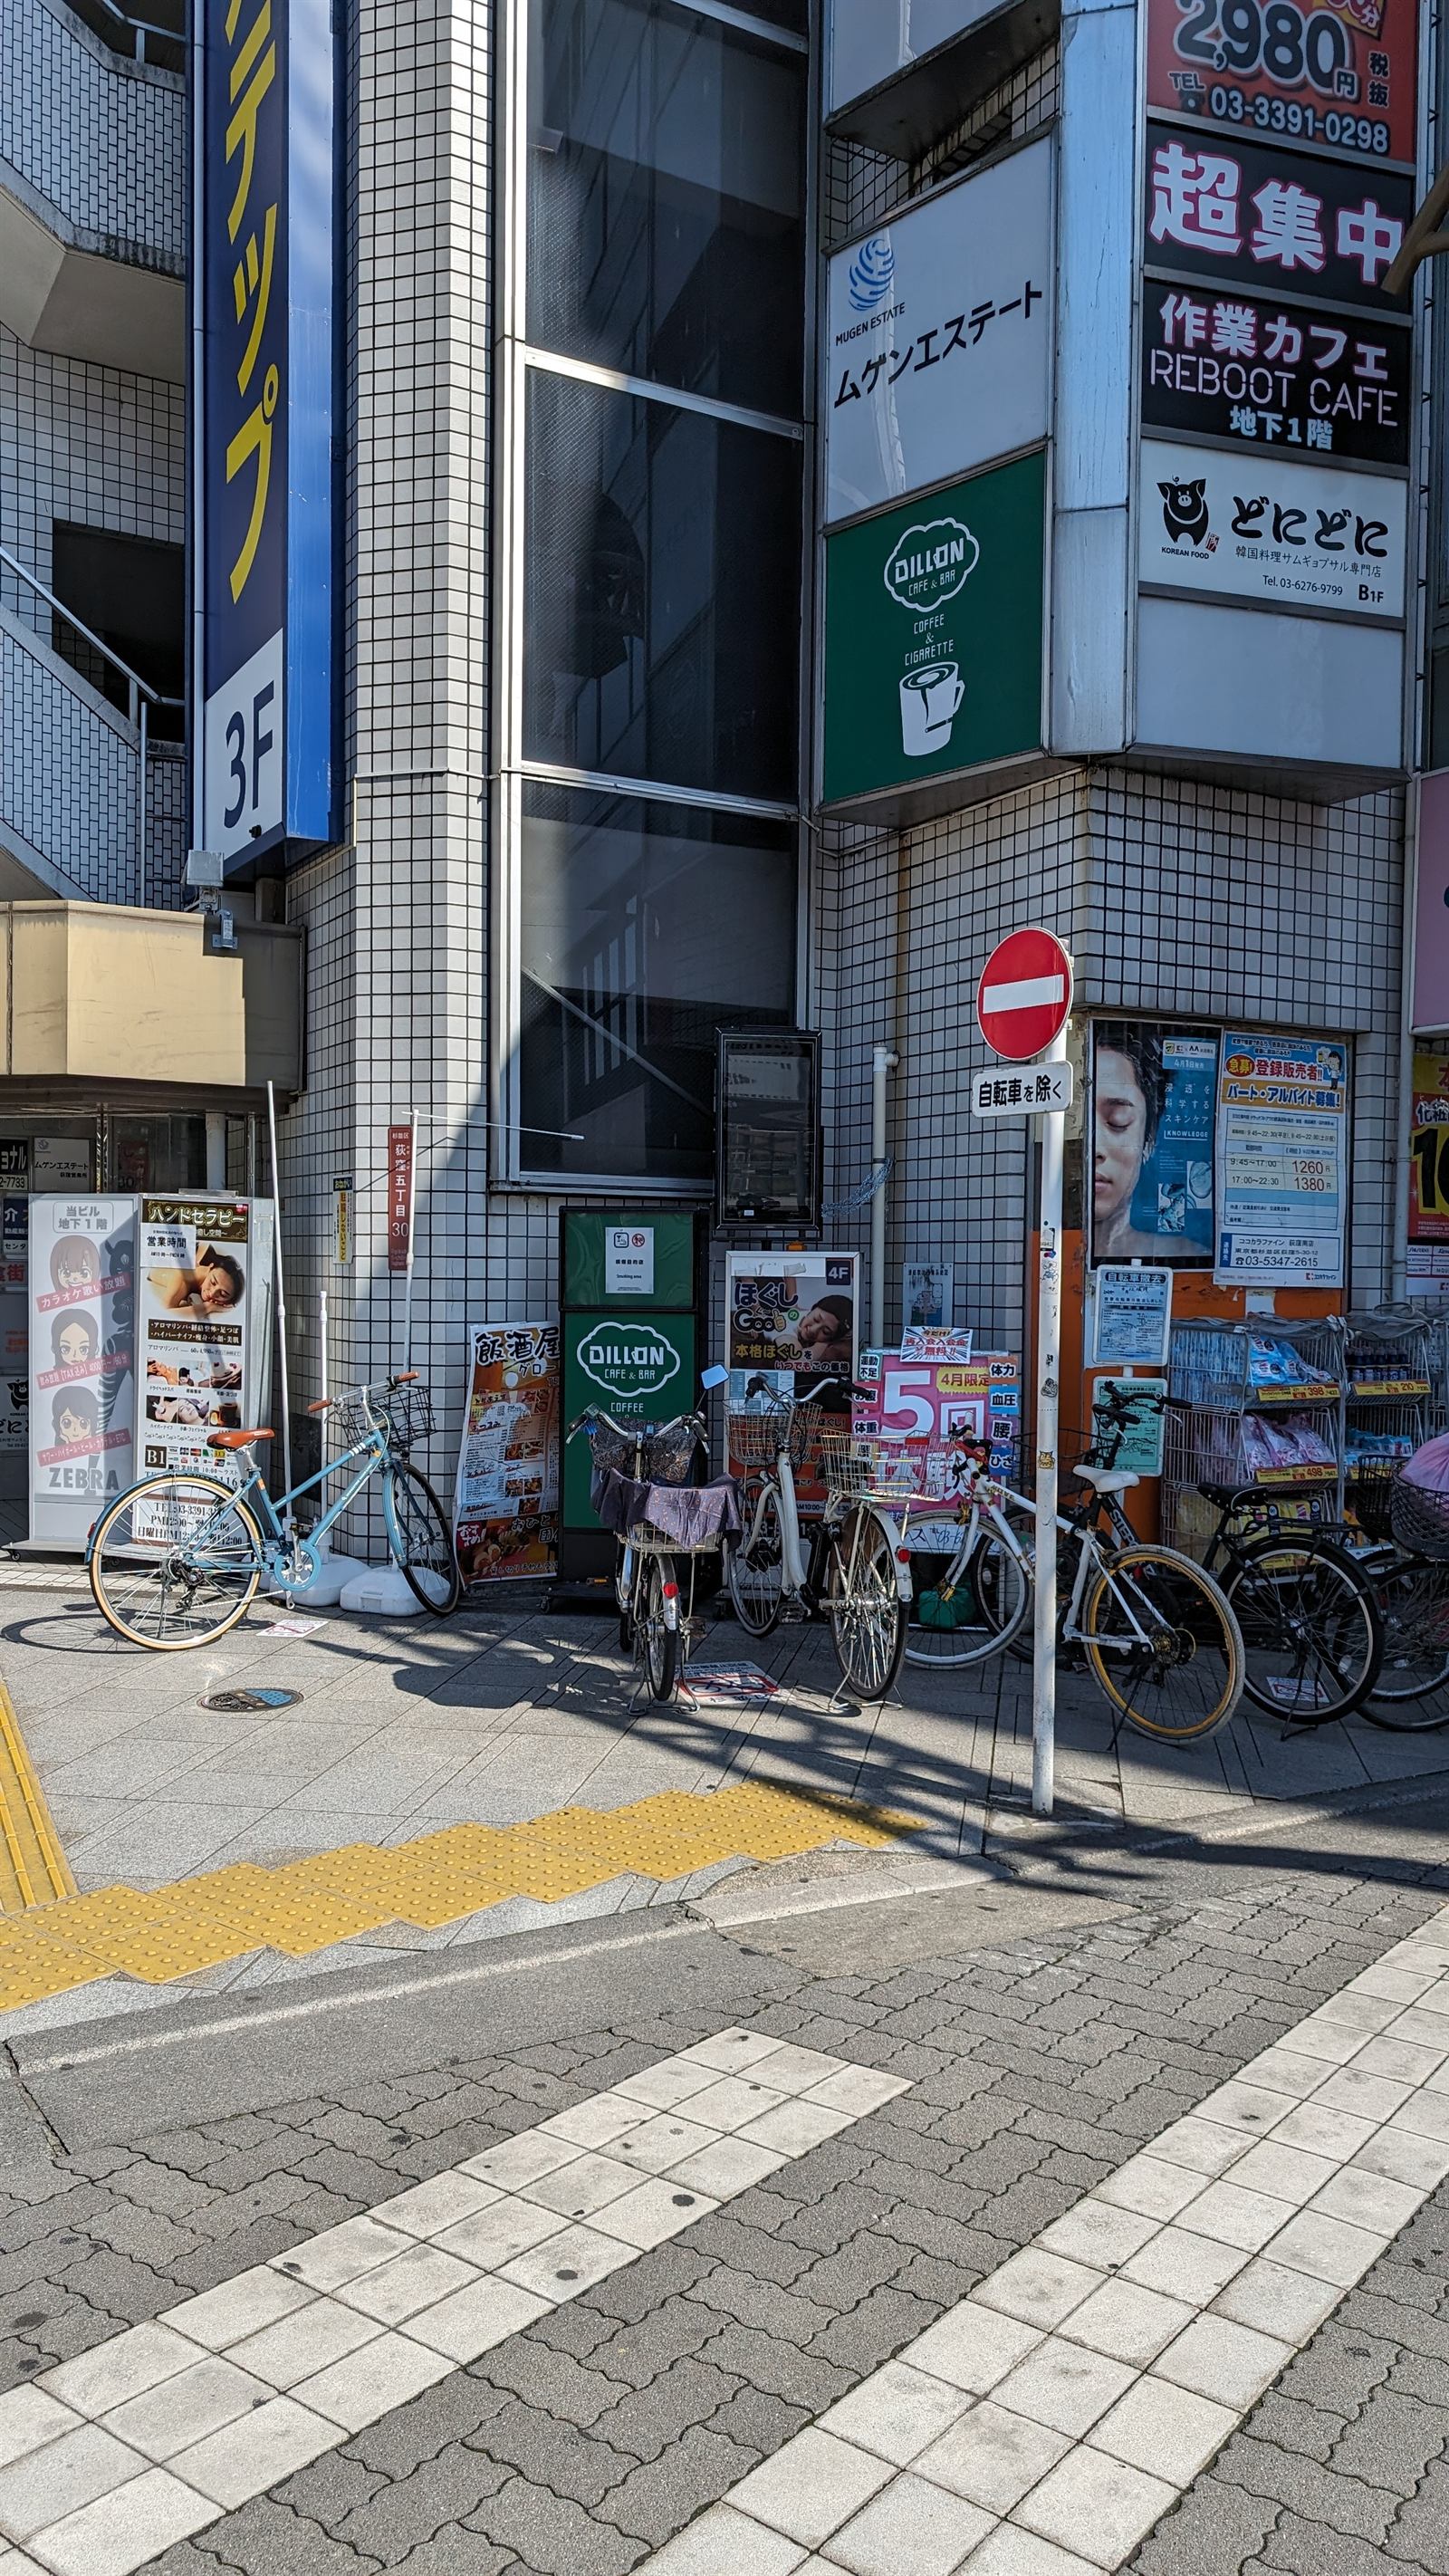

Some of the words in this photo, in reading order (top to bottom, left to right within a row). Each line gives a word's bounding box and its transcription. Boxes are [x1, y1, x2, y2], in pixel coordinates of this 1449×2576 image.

[1169, 72, 1205, 90] TEL
[1368, 51, 1389, 107] 税抜
[1211, 87, 1389, 154] 03-3391-0298
[1149, 142, 1403, 284] 超集中
[836, 321, 869, 346] MUGEN
[870, 302, 906, 329] ESTATE
[834, 280, 1042, 409] ムゲンエステート
[1159, 293, 1389, 381] 作業カフェ
[1150, 349, 1296, 408] REBOOT
[1310, 379, 1398, 427] CAFE
[1230, 405, 1334, 450] 地下1階
[1232, 495, 1388, 557] どにどに
[895, 537, 964, 584] DILLON
[1161, 546, 1190, 558] KOREAN
[1191, 549, 1210, 560] FOOD
[1235, 545, 1382, 579] 韓国料理サムギョプサル専門店
[908, 580, 928, 596] CAFE
[930, 580, 938, 590] &
[940, 570, 955, 587] BAR
[1262, 575, 1278, 588] Tel.
[1280, 578, 1343, 596] 03-6276-9799
[1358, 583, 1384, 603] B1F
[914, 614, 945, 634] COFFEE
[926, 632, 935, 644] &
[905, 639, 954, 666] CIGARETTE
[224, 679, 274, 830] 3F
[1256, 1059, 1322, 1081] 登録販売者!!
[979, 1074, 1061, 1108] 自転車を除く
[1227, 1084, 1340, 1109] パート・アルバイト募集!
[1165, 1115, 1209, 1124] スキンケア
[1167, 1129, 1208, 1139] KNOWLEDGE
[34, 1160, 88, 1170] ムゲンエステート
[395, 1144, 407, 1217] 荻窪五丁目
[66, 1206, 101, 1217] 当ビル
[150, 1206, 245, 1227] ハンドセラピー
[58, 1218, 108, 1230] 地下1階
[392, 1223, 408, 1237] 30
[147, 1235, 187, 1249] 営業時間
[1239, 1238, 1285, 1246] ココカラファイン
[1245, 1256, 1319, 1266] 03-5347-2615
[828, 1267, 849, 1279] 4F
[42, 1276, 125, 1308] カラオケ歌い放題
[734, 1283, 799, 1307] ほぐし
[475, 1326, 560, 1365] 飯酒屋
[590, 1346, 665, 1365] DILLON
[860, 1356, 878, 1366] 運動
[604, 1369, 627, 1379] CAFE
[629, 1371, 637, 1380] &
[638, 1369, 656, 1380] BAR
[775, 1361, 849, 1371] いつでもこの価格
[860, 1368, 878, 1378] 不足
[991, 1363, 1015, 1377] 体力
[941, 1373, 989, 1387] 4月限定
[1308, 1387, 1324, 1396] 398
[610, 1402, 644, 1413] COFFEE
[992, 1394, 1017, 1408] 血圧
[854, 1421, 878, 1434] 体重
[993, 1423, 1012, 1438] 腰
[147, 1449, 165, 1464] B1
[990, 1455, 1013, 1468] ひざ
[49, 1467, 120, 1490] ZEBRA
[1307, 1468, 1322, 1476] 498
